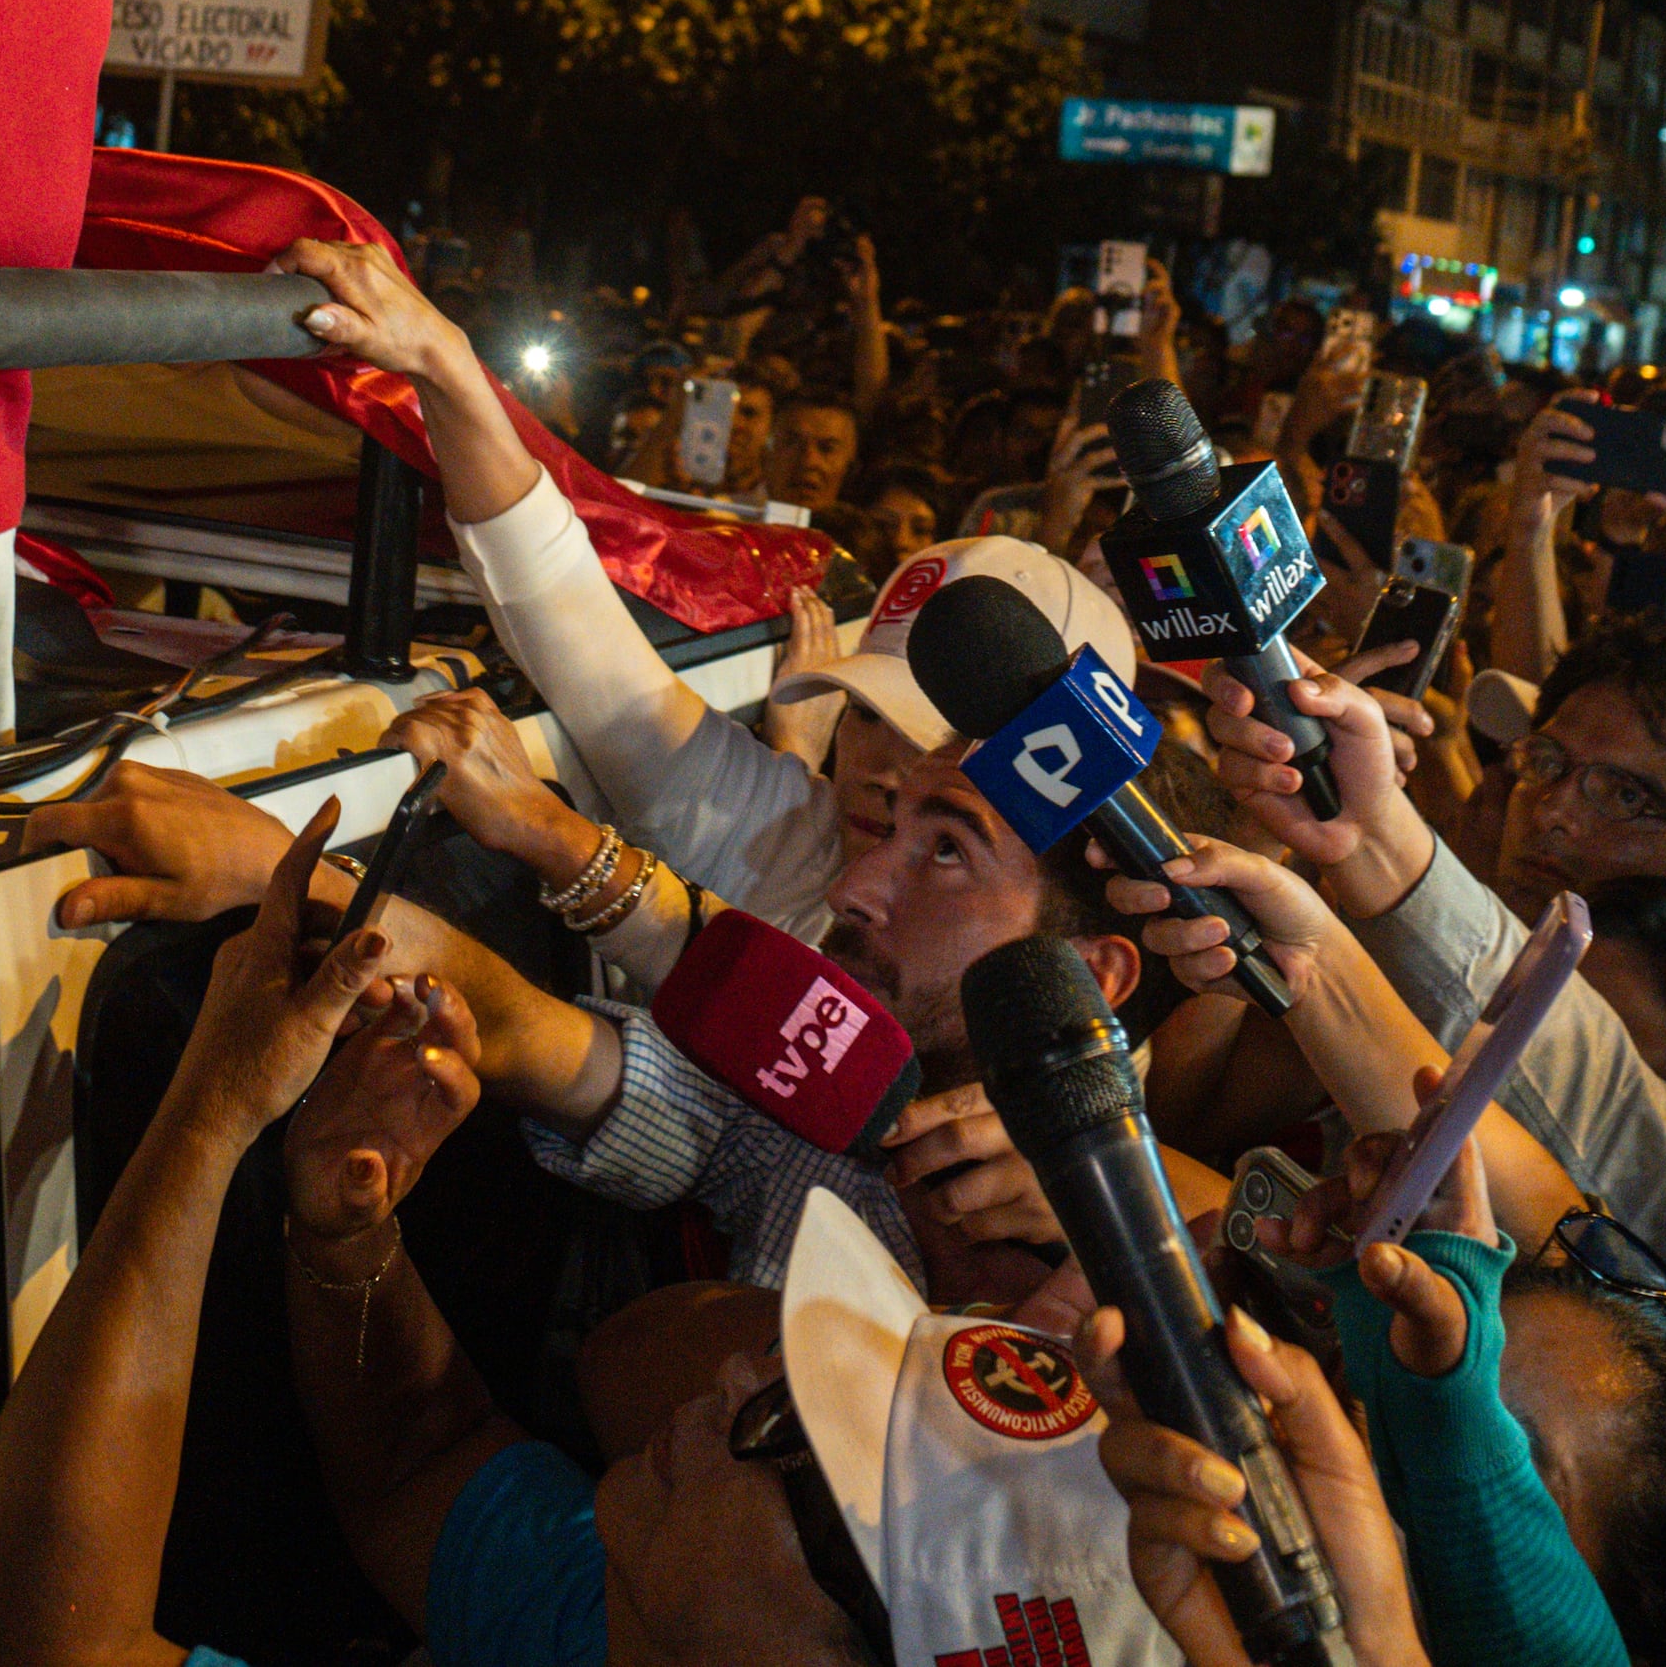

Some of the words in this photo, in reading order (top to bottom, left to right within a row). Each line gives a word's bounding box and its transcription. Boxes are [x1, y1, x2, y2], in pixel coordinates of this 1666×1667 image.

[1249, 549, 1313, 623] willax
[1141, 607, 1237, 640] willax
[958, 1377, 1068, 1433] ANTICOMUNISTA
